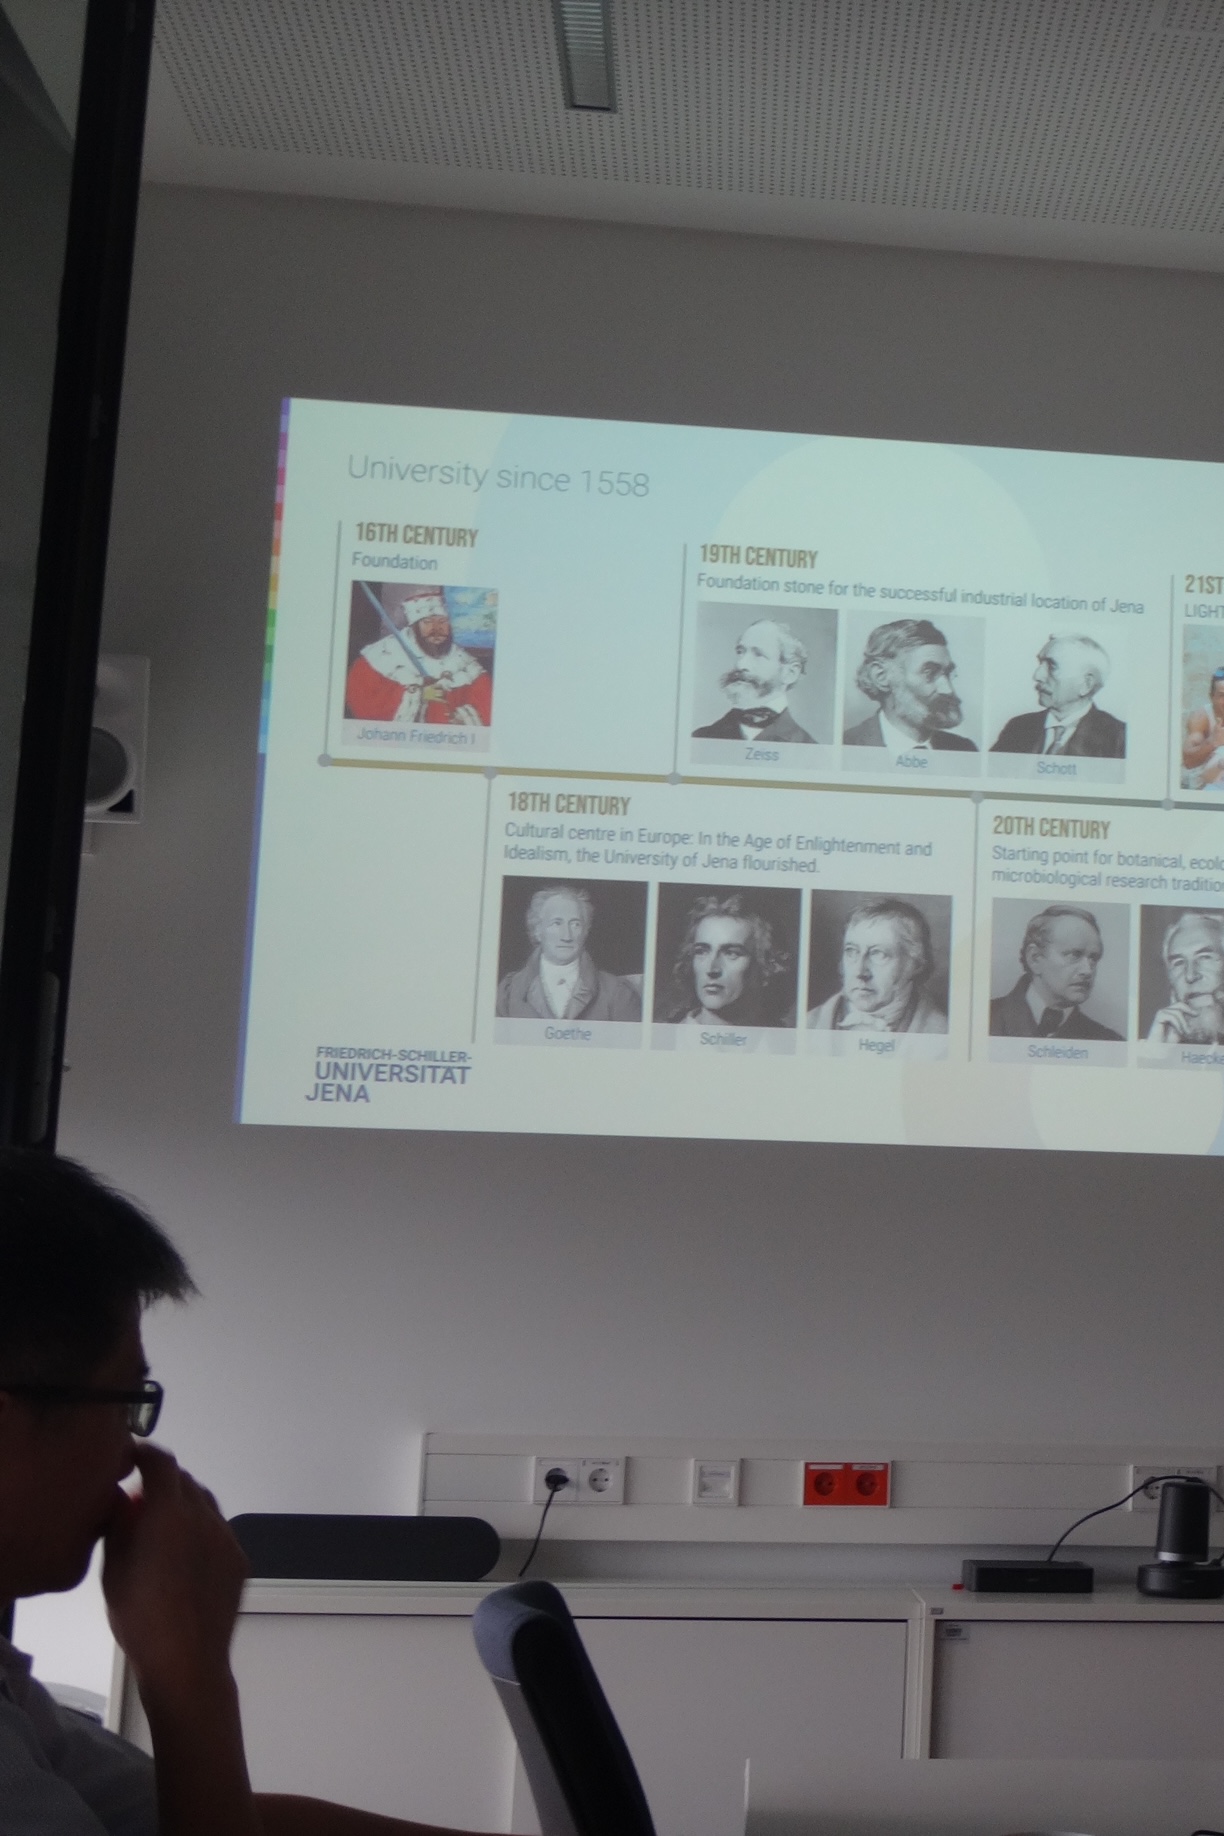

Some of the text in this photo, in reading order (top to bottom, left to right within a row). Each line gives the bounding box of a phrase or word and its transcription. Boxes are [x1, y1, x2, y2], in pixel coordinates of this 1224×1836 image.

[348, 454, 650, 497] University since 1558
[355, 521, 478, 548] 16TH CENTURY
[352, 551, 437, 571] Foundation
[700, 543, 818, 569] 19TH CENTURY
[697, 572, 1144, 614] Foundation stone for the successful industrial location of Jena
[1185, 574, 1224, 595] 21ST
[357, 727, 406, 745] Johann
[410, 728, 467, 745] Friedrich
[745, 747, 779, 762] Zeiss
[896, 754, 928, 769] Abbe
[1037, 761, 1076, 776] Schott
[509, 791, 631, 817] 18TH CENTURY
[993, 815, 1110, 840] 20TH CENTURY
[505, 822, 932, 857] Cultural centre in Europe: In the Age of Enlightenment and
[504, 845, 820, 873] Idealism, the University of Jena flourished.
[992, 845, 1048, 865] Starting
[1053, 849, 1089, 867] point
[1093, 850, 1113, 865] for
[1117, 852, 1186, 871] botanical,
[992, 868, 1101, 888] microbiological
[1105, 873, 1167, 890] research
[545, 1026, 592, 1041] Goethe
[700, 1031, 747, 1047] Schiller
[859, 1037, 895, 1054] Hegel
[1028, 1044, 1088, 1060] Schleiden
[305, 1083, 370, 1103] JENA
